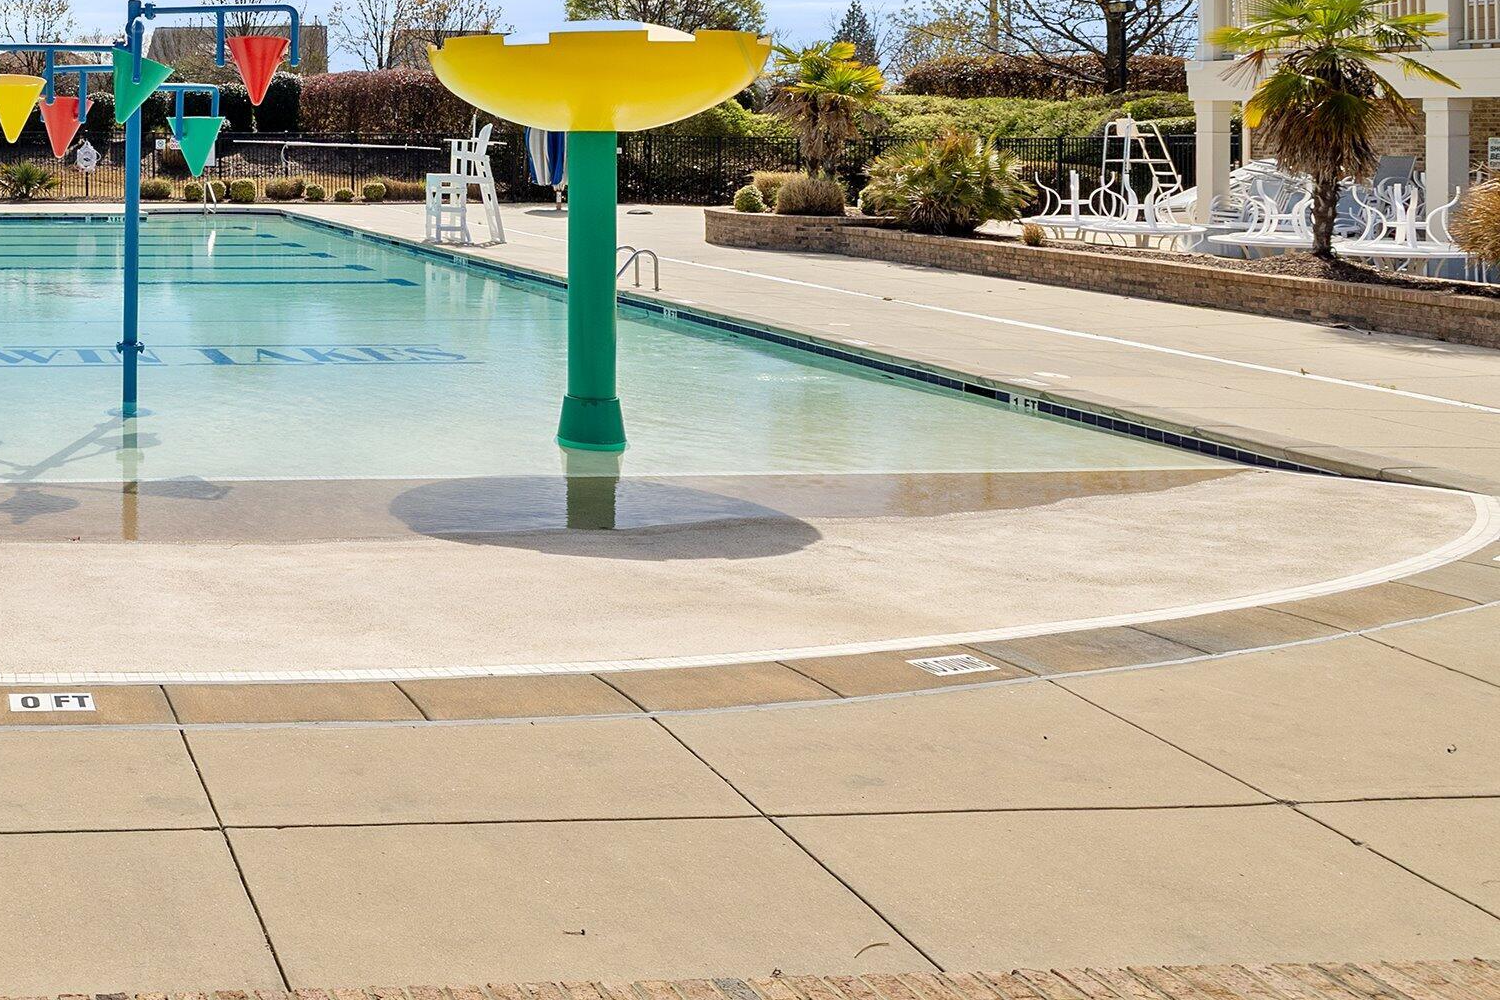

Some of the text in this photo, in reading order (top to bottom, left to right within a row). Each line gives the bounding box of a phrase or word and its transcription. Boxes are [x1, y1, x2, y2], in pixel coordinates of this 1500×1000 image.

[192, 346, 468, 366] LAKES
[1024, 398, 1037, 410] FT
[20, 695, 90, 709] 0 FT
